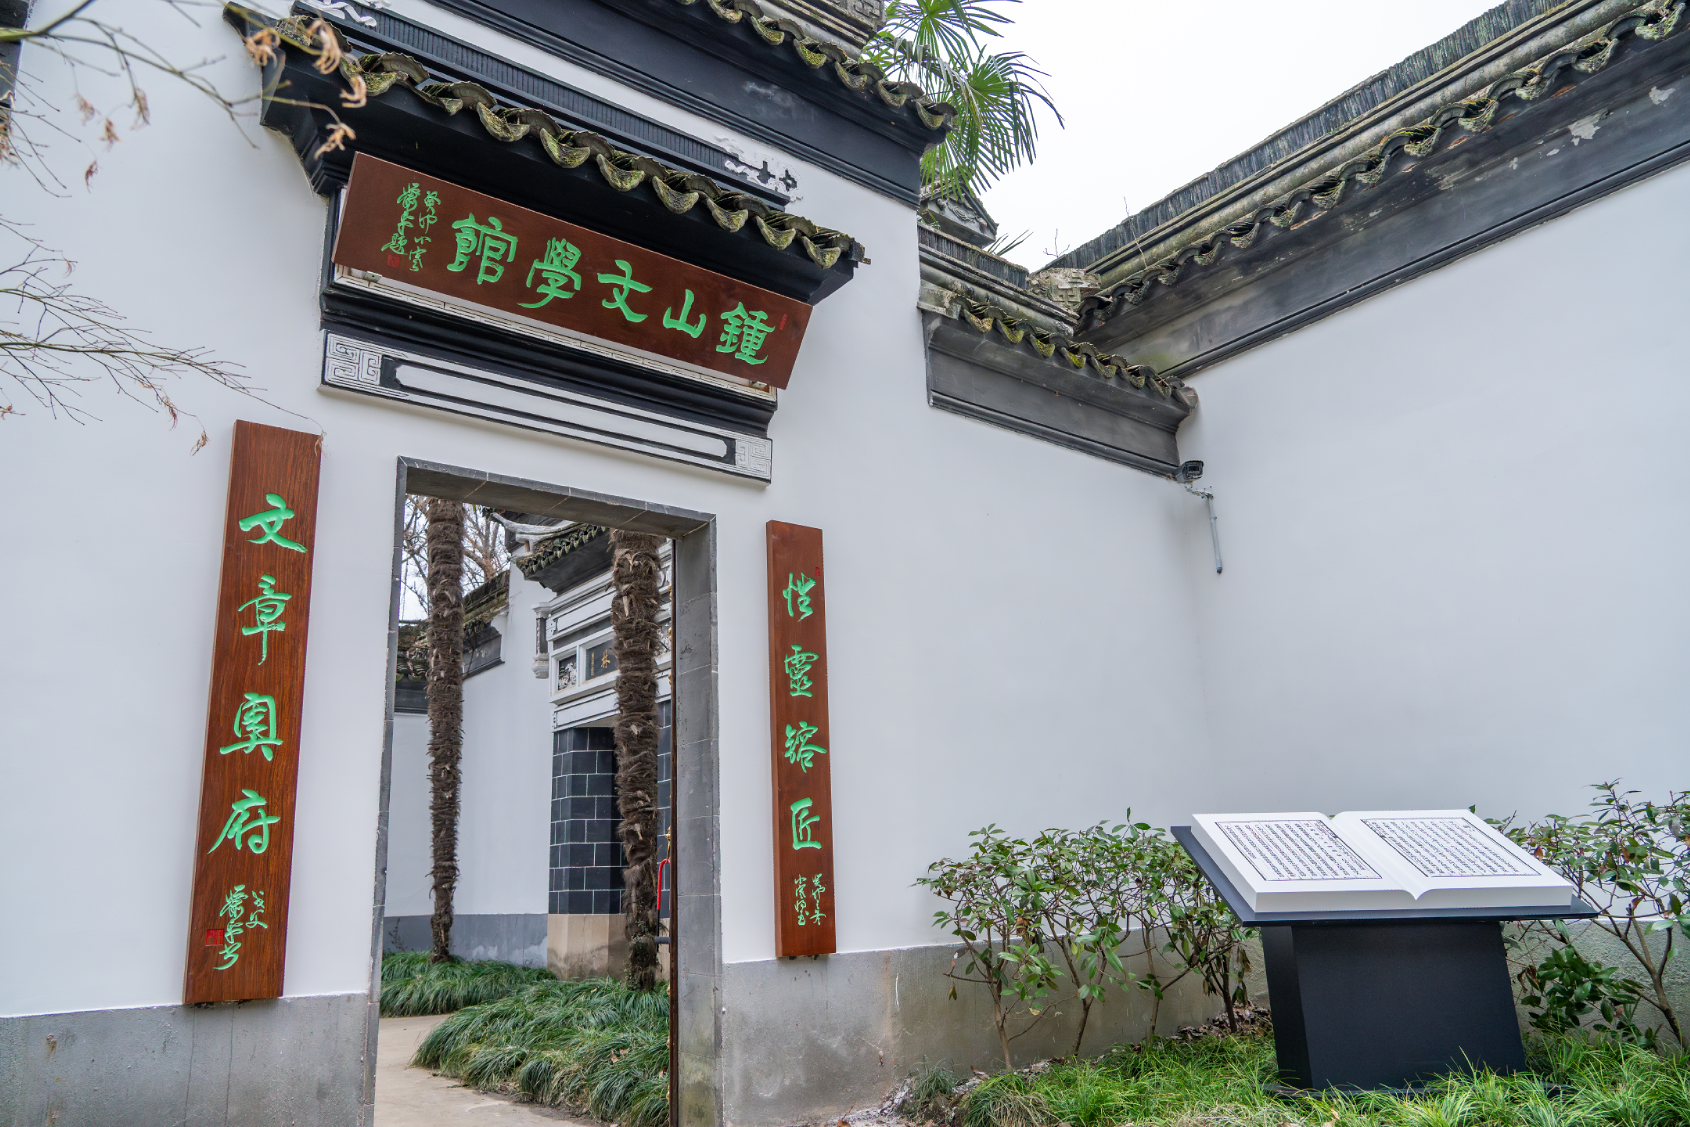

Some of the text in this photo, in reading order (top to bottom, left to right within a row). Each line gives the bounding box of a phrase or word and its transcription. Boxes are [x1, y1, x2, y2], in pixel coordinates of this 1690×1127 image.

[446, 212, 776, 366] 鍾山文學館
